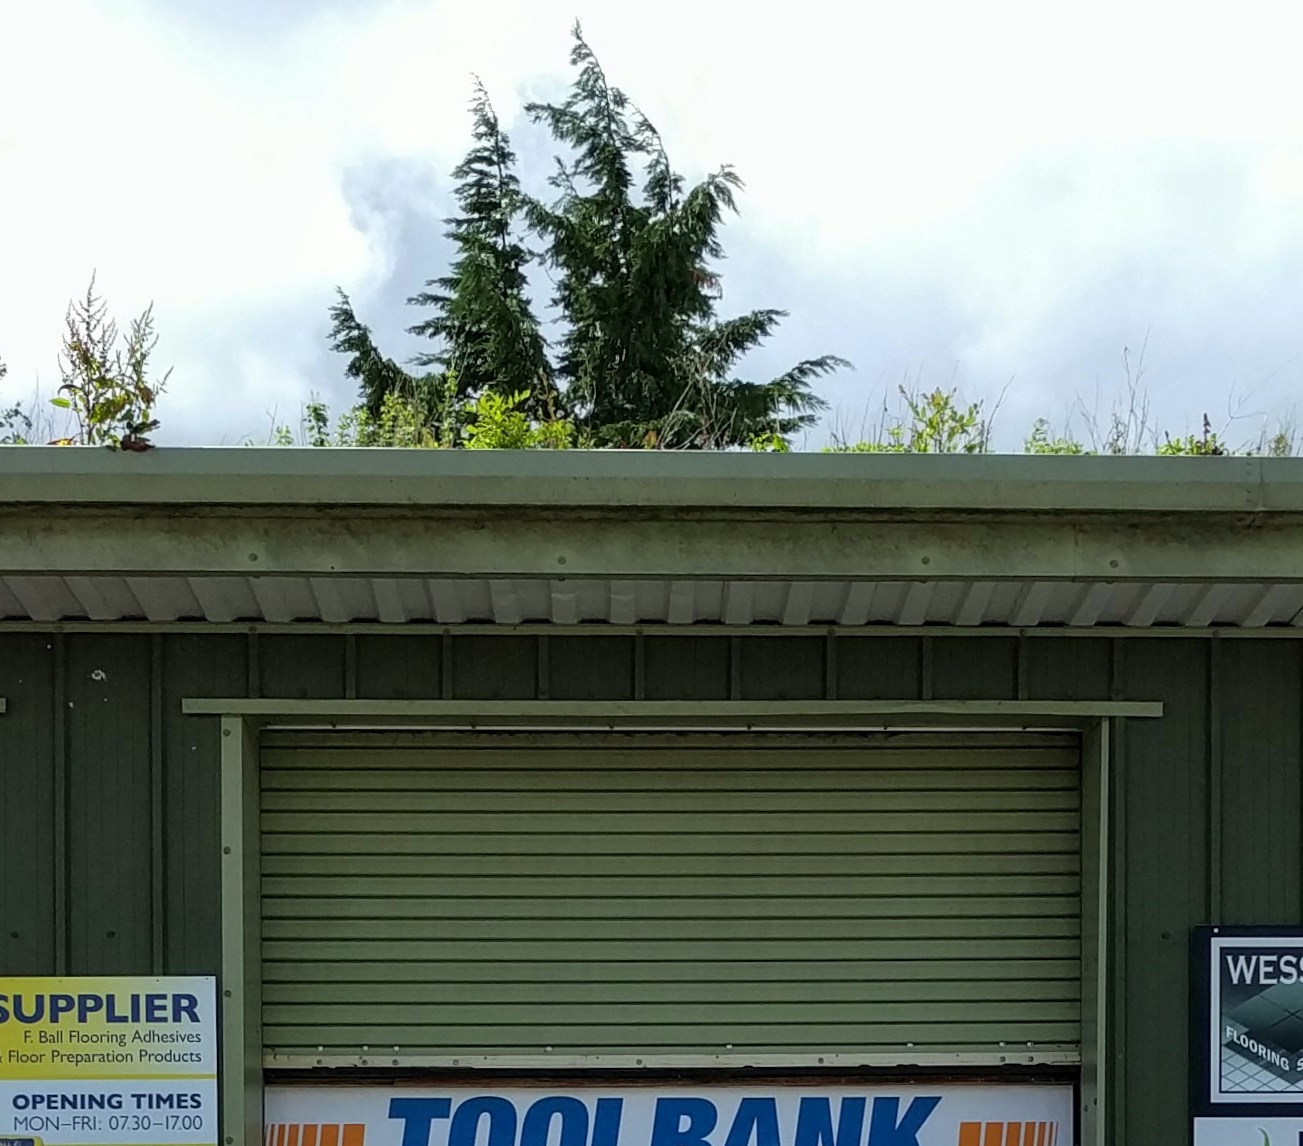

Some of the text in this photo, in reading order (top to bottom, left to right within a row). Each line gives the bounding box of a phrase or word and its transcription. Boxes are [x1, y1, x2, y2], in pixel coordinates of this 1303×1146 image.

[24, 1031, 201, 1046] F. Ball Flooring Adhesives
[1226, 1025, 1290, 1072] FLOORING
[8, 1050, 46, 1063] Floor
[51, 1050, 133, 1067] Preparation
[140, 1050, 202, 1063] Products
[12, 1093, 202, 1110] OPENING TIMES
